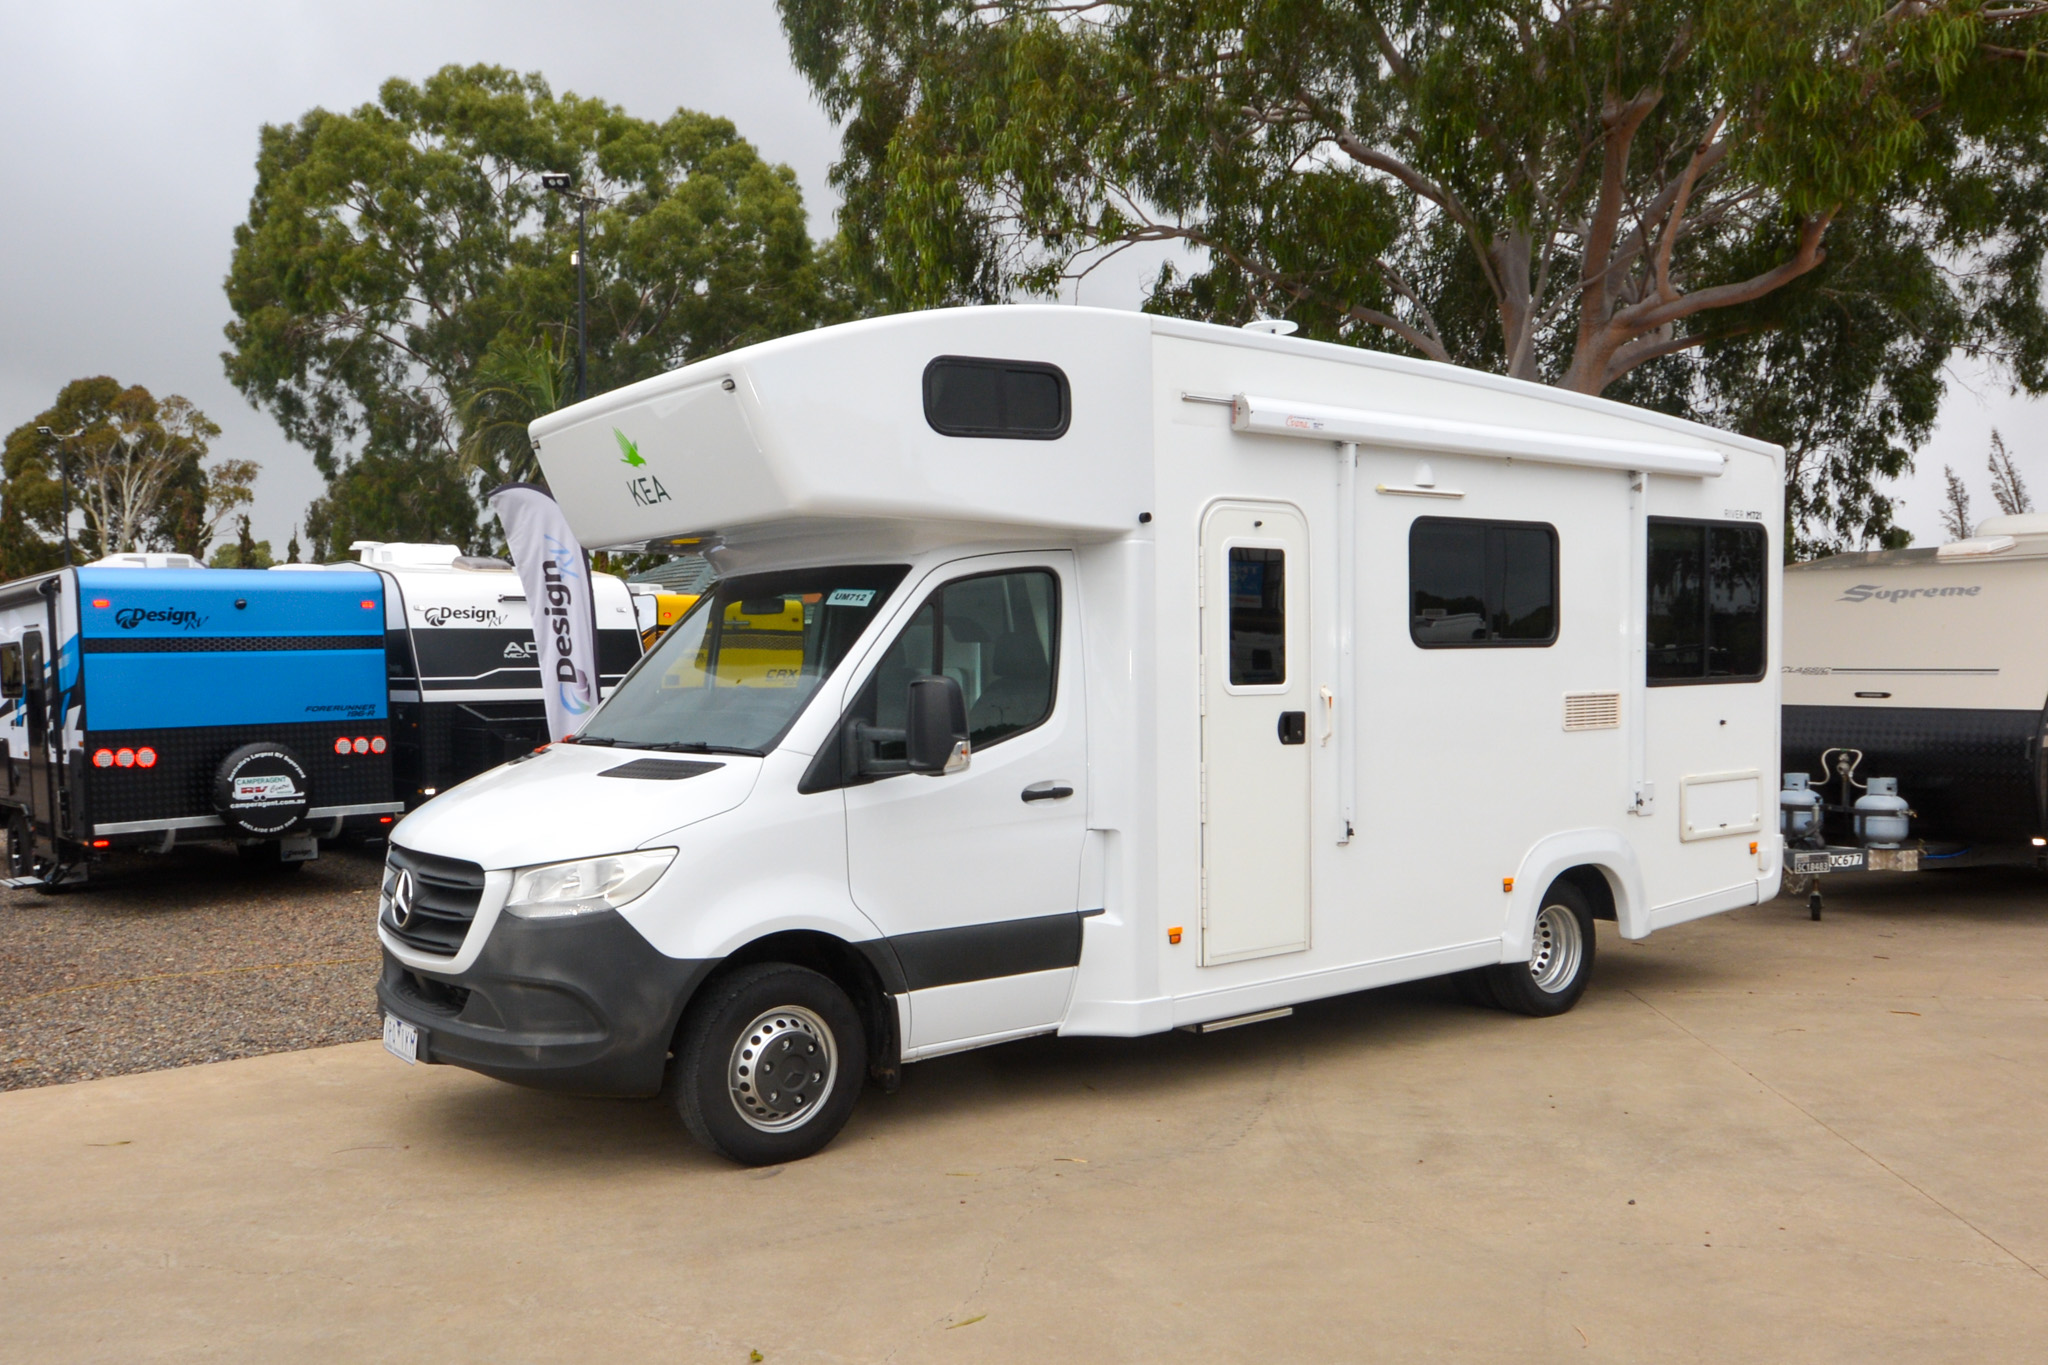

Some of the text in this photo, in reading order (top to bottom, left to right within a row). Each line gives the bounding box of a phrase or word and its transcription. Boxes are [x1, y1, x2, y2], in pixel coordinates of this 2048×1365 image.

[626, 475, 672, 507] KEA
[834, 592, 867, 601] UM712
[1835, 584, 1981, 603] Supreme
[440, 605, 508, 628] Design RV
[542, 534, 579, 683] Design RV
[132, 606, 209, 631] Design RV
[304, 704, 376, 713] FORERUNNER
[236, 776, 286, 786] CAMPERAGENT
[241, 785, 268, 794] RV
